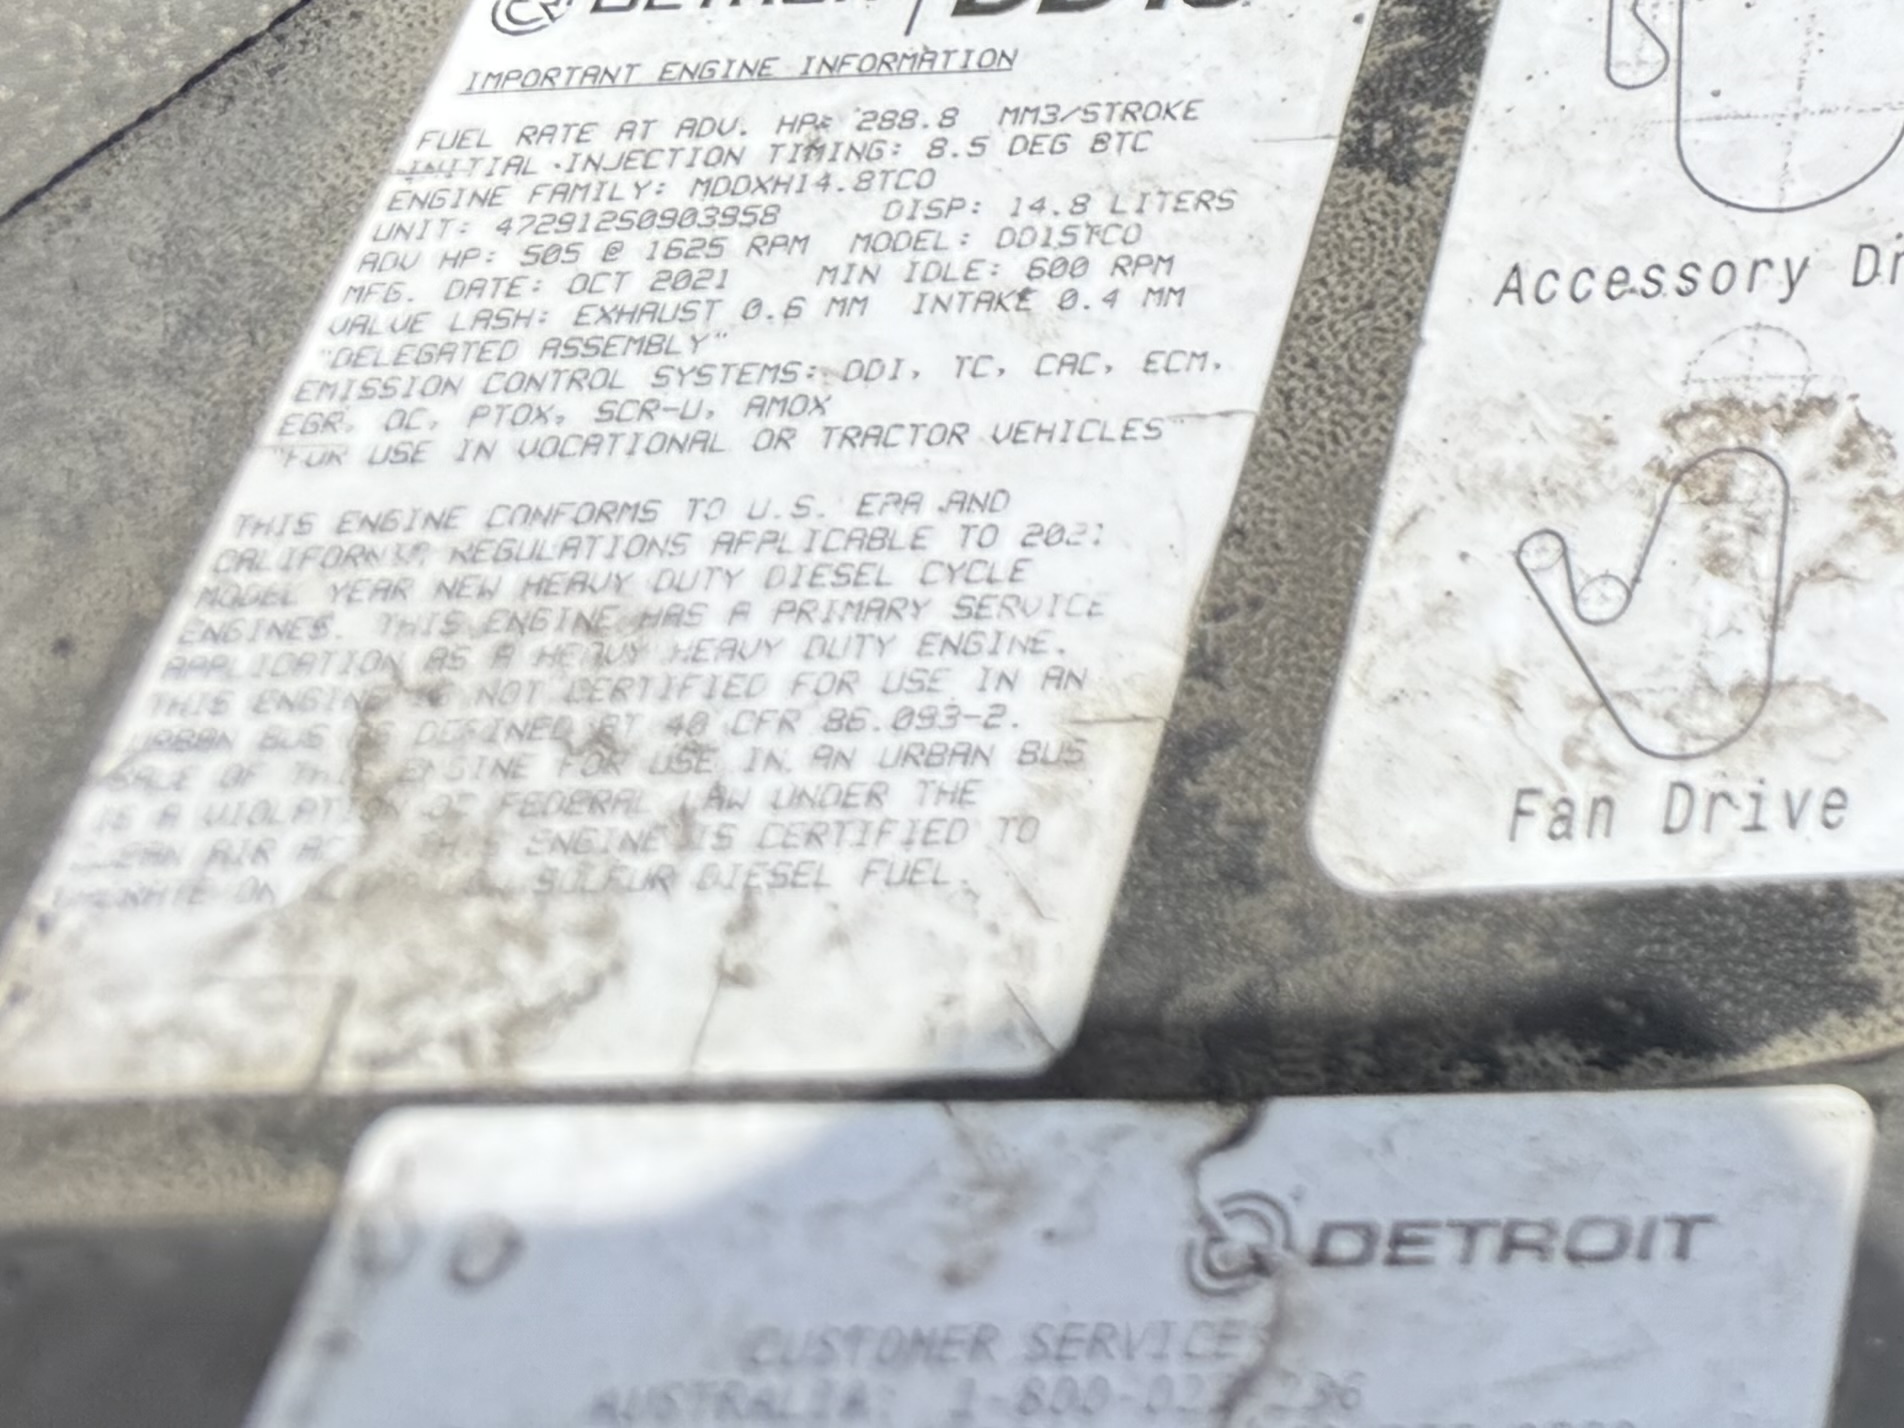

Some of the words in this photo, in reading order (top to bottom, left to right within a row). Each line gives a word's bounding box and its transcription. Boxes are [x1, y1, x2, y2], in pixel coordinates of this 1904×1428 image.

[464, 63, 642, 93] IMPORTANT
[657, 56, 780, 82] ENGINE
[799, 48, 1019, 77] INFORMATION
[416, 128, 493, 151] FUEL
[515, 122, 600, 148] RATE
[614, 119, 658, 142] AT
[674, 116, 749, 140] ADV.
[855, 106, 960, 132] 288.8
[998, 98, 1205, 127] MM3/STROKE
[562, 145, 747, 172] INJECTION
[769, 139, 903, 165] TIMING:
[926, 135, 990, 160] 8.5
[1007, 132, 1074, 156] DEG
[1089, 129, 1154, 154] BTC
[371, 217, 470, 243] UNIT:
[882, 197, 983, 222] DISP:
[1009, 192, 1093, 218] 14.8
[1109, 188, 1239, 217] LITERS
[386, 185, 513, 212] ENGINE
[527, 180, 668, 206] FAMILY:
[357, 251, 422, 275] ADV
[438, 247, 497, 271] HP:
[519, 242, 583, 268] 505
[600, 239, 626, 263] @
[644, 236, 730, 263] 1625
[744, 233, 811, 259] RPM
[849, 227, 973, 254] MODEL:
[342, 279, 416, 305] MFG.
[443, 274, 542, 302] DATE:
[566, 270, 632, 296] OCT
[648, 267, 731, 293] 2021
[816, 261, 881, 287] MIN
[902, 257, 1001, 284] IDLE:
[1025, 254, 1091, 281] 600
[1110, 253, 1176, 278] RPM
[1493, 254, 1810, 307] Accessory
[327, 310, 433, 336] VALVE
[448, 305, 549, 333] LASH:
[573, 298, 725, 328] EXHAUST
[741, 295, 805, 321] 0.6
[824, 294, 869, 319] MM
[911, 287, 1040, 316] INTAKE
[1056, 286, 1120, 311] 0.4
[1140, 285, 1187, 310] MM
[536, 331, 729, 360] ASSEMBLY"
[293, 373, 466, 403] EMISSION
[481, 367, 627, 397] CONTROL
[650, 359, 817, 389] SYSTEMS:
[955, 354, 1008, 378] TC,
[1033, 350, 1117, 377] CAC,
[1141, 349, 1223, 376] ECM,
[466, 402, 566, 431] PTOX,
[594, 397, 716, 425] SCR-U,
[743, 394, 833, 419] AMOX
[365, 439, 435, 468] USE
[453, 437, 498, 464] IN
[516, 429, 730, 461] VOCATIONAL
[752, 428, 798, 454] OR
[821, 421, 972, 451] TRACTOR
[236, 510, 320, 539] THIS
[334, 504, 468, 536] ENGINE
[484, 499, 663, 531] CONFORMS
[687, 495, 728, 522] TO
[746, 493, 826, 521] U.S.
[855, 490, 926, 518] EPA
[946, 487, 1012, 515] AND
[449, 533, 693, 564] REGULATIONS
[710, 523, 936, 557] APPLICABLE
[959, 522, 999, 549] TO
[330, 577, 417, 604] YEAR
[433, 574, 505, 601] NEW
[521, 570, 636, 600] HEAVY
[651, 566, 746, 594] DUTY
[763, 560, 895, 591] DIESEL
[918, 556, 1034, 587] CYCLE
[483, 603, 621, 636] ENGINE
[638, 601, 709, 630] HAS
[727, 599, 752, 628] A
[772, 595, 933, 626] PRIMARY
[951, 591, 1107, 622] SERVICE
[803, 632, 902, 663] DUTY
[915, 629, 1068, 659] ENGINE.
[474, 677, 544, 706] NOT
[789, 668, 862, 700] FOR
[880, 666, 953, 696] USE
[976, 666, 1021, 694] IN
[1039, 664, 1089, 693] AN
[730, 707, 801, 738] CFR
[821, 703, 1021, 736] 86.093-2.
[647, 747, 719, 777] USE
[877, 738, 996, 770] URBAN
[1016, 737, 1090, 766] BUS
[770, 781, 891, 811] UNDER
[914, 777, 984, 809] THE
[1508, 787, 1616, 843] Fan
[1661, 777, 1849, 836] Drive
[755, 815, 970, 851] CERTIFIED
[996, 814, 1042, 845] TO
[697, 857, 834, 892] DIESEL
[1308, 1214, 1718, 1268] DETROIT
